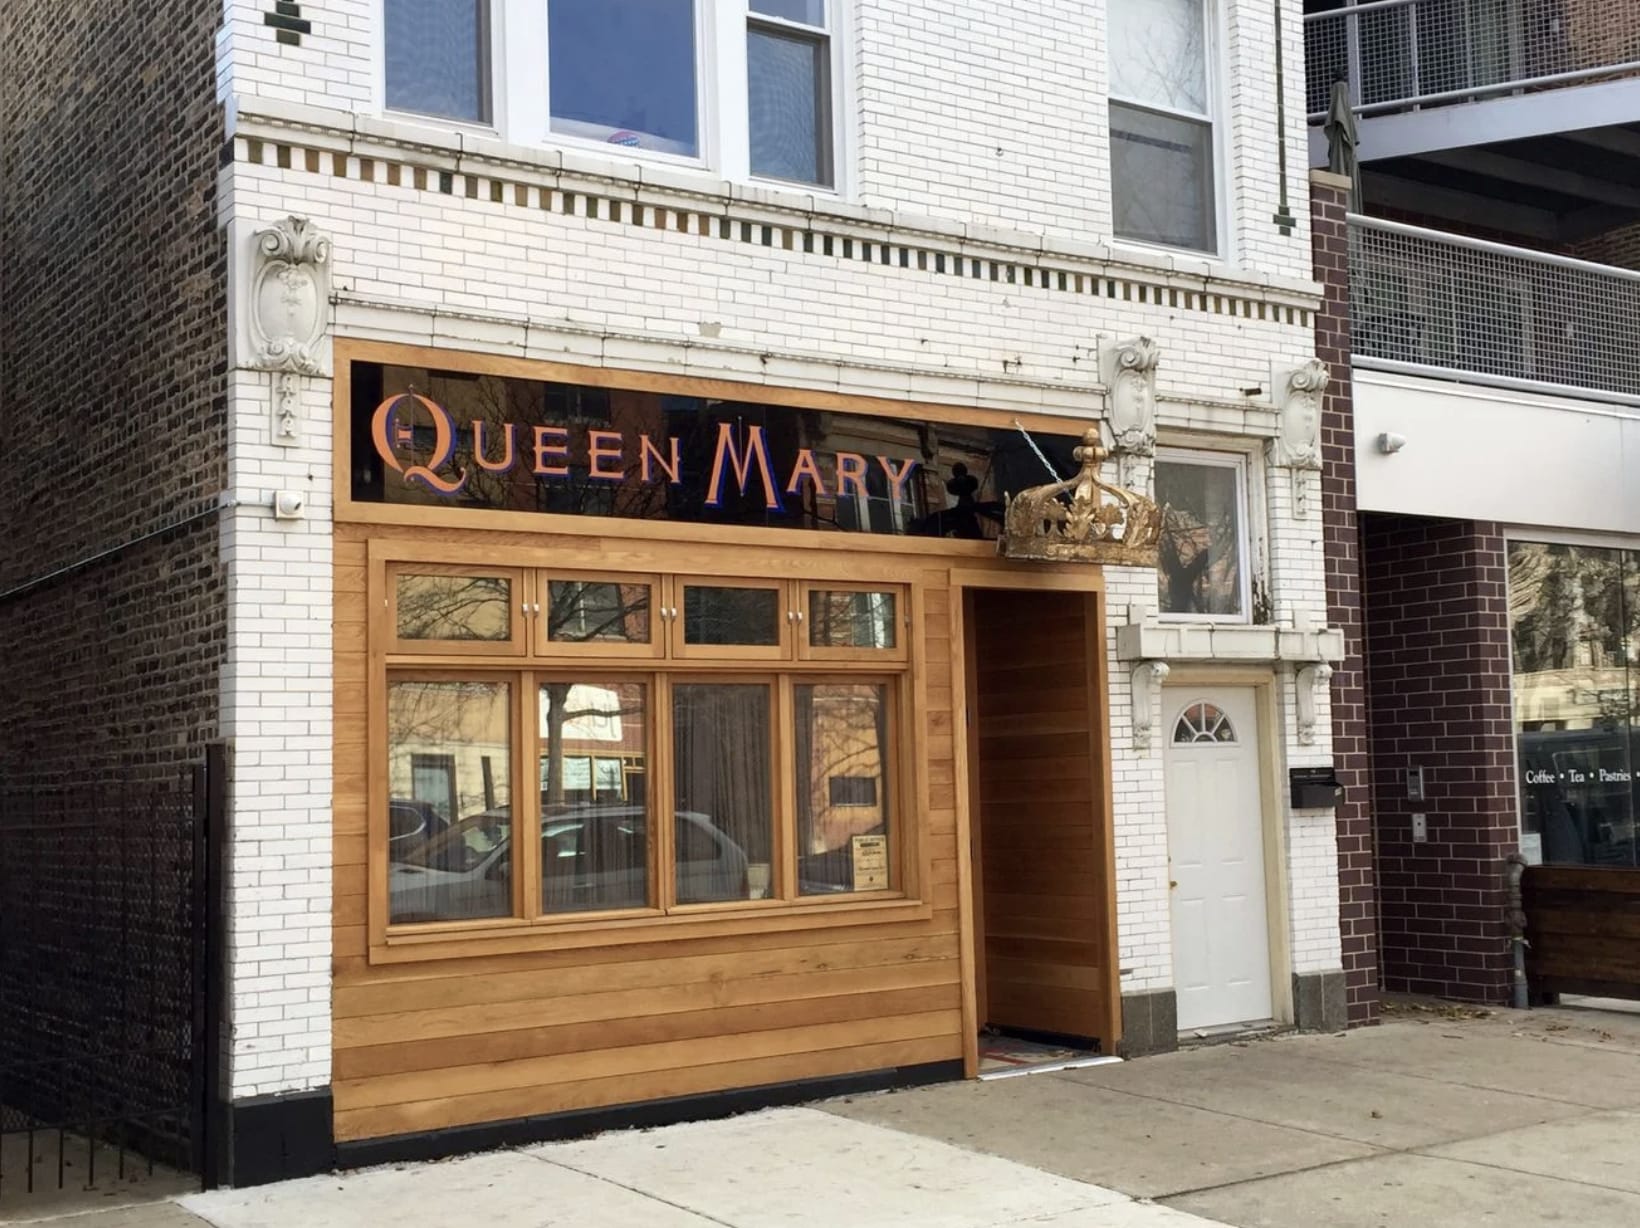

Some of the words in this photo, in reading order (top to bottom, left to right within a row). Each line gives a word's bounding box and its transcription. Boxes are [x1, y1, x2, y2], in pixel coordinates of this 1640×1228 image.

[704, 420, 918, 513] MARY
[1525, 769, 1556, 784] Coffee
[1567, 769, 1585, 783] Tea
[1598, 767, 1632, 782] Pastries
